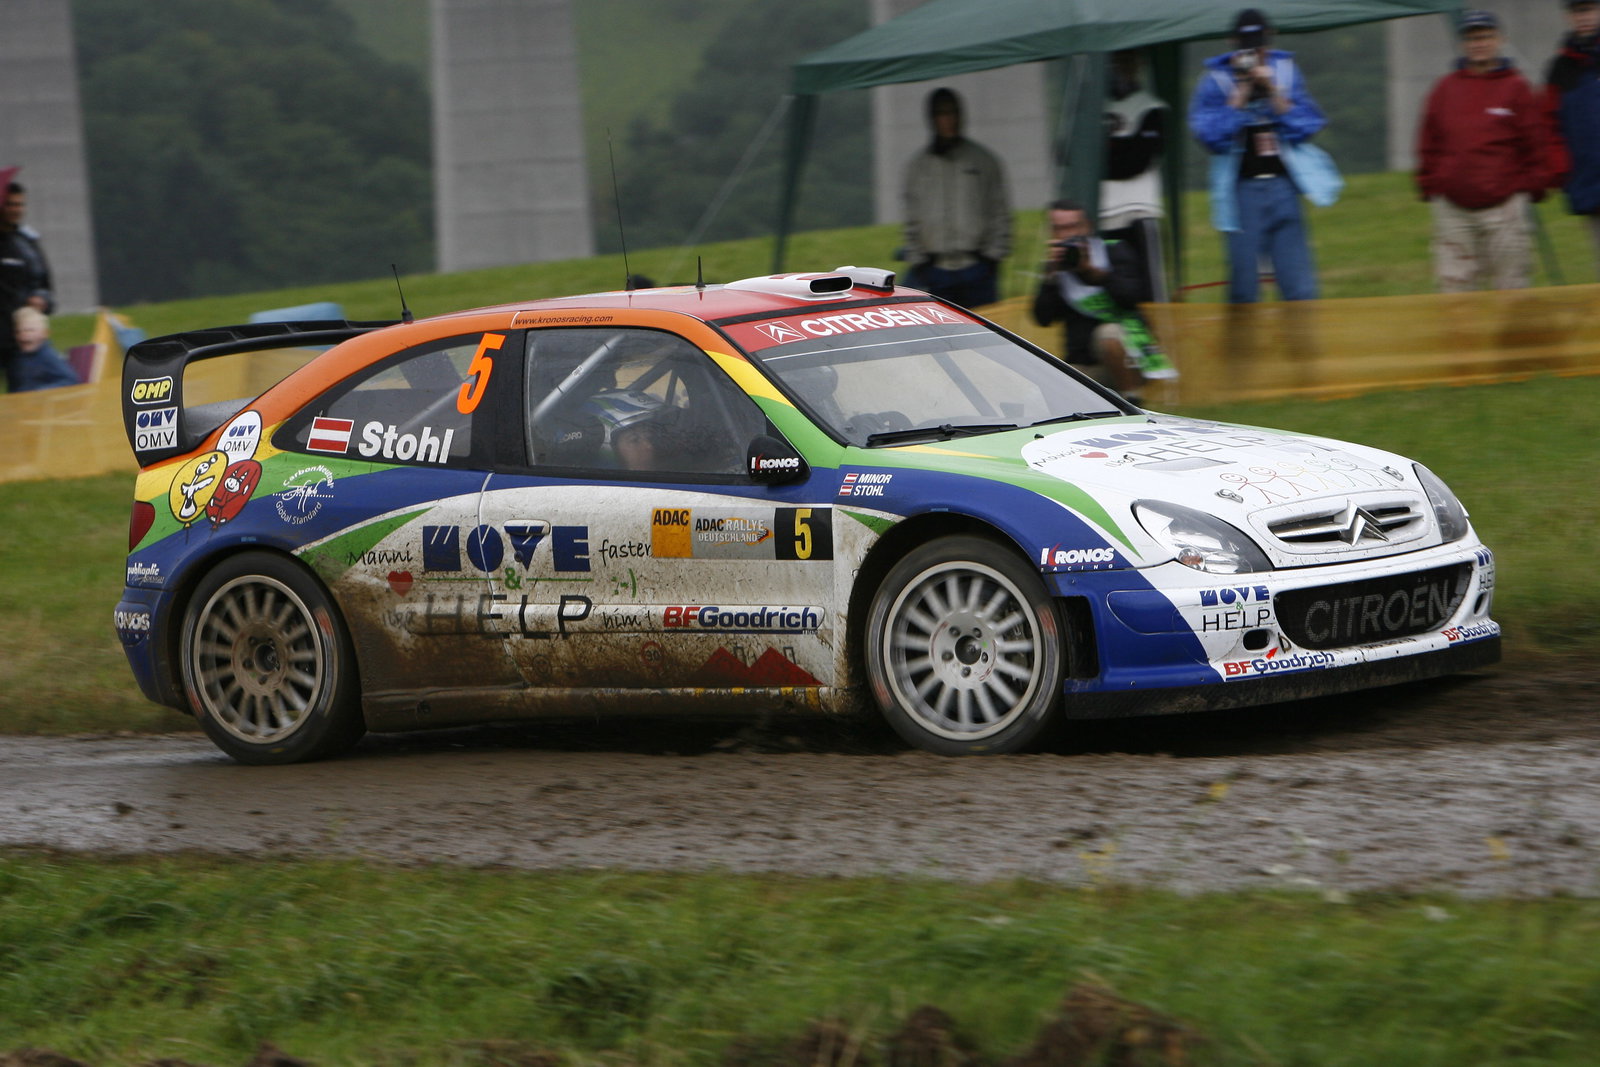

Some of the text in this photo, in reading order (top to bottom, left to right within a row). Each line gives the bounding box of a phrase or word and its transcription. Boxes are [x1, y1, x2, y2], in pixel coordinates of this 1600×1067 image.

[515, 314, 613, 325] www.kronosracing.com
[800, 308, 935, 337] CITROËN
[456, 333, 506, 415] 5
[133, 379, 171, 400] OMP
[137, 430, 175, 449] OMV
[223, 440, 252, 452] OMV
[358, 421, 455, 464] Stohl
[854, 485, 884, 496] STOHL
[858, 474, 893, 484] MINOR
[275, 500, 322, 525] Global Standard
[653, 510, 690, 526] ADAC
[695, 518, 765, 531] ADAC RALLYE
[794, 509, 813, 560] 5
[698, 532, 758, 542] DEUTSCHLAND
[348, 542, 414, 566] Manni
[598, 538, 651, 567] faster
[1041, 543, 1115, 566] KRONOS
[504, 567, 522, 590] &
[425, 594, 593, 640] HELP
[663, 606, 818, 628] BFGoodrich
[1202, 609, 1270, 632] HELP
[1305, 577, 1450, 643] CITROËN
[1223, 652, 1336, 676] BFGoodrich
